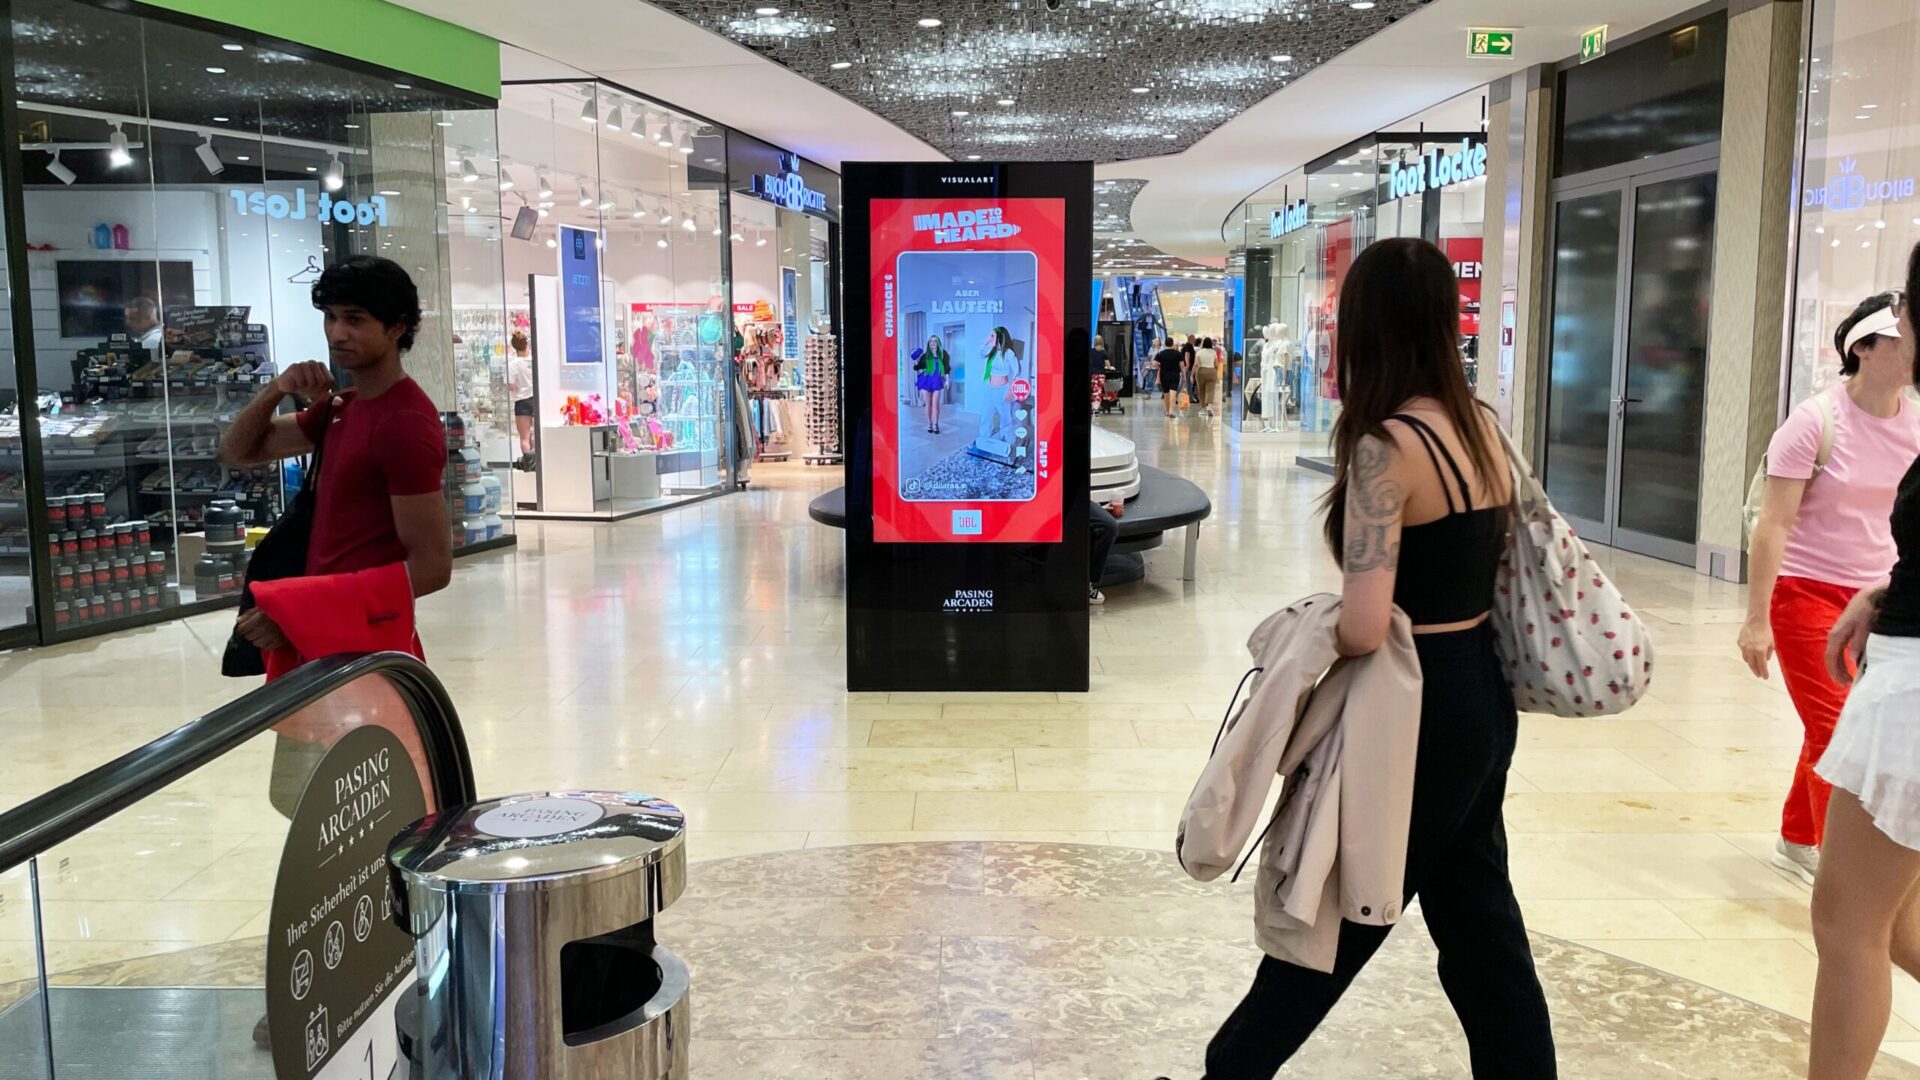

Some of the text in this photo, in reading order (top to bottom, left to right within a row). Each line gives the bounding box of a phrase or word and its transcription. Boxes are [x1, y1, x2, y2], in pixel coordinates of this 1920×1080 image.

[1390, 137, 1487, 200] Foot Locke
[918, 208, 988, 231] MADE
[987, 208, 1002, 216] TO
[934, 223, 1014, 243] HEARD
[884, 282, 893, 337] CHARGE
[931, 300, 1004, 313] LAUTER!
[1013, 384, 1029, 394] JBL
[1039, 441, 1047, 467] FLIP
[959, 516, 977, 528] JBL
[943, 599, 993, 607] ARCADEN
[955, 590, 993, 598] PASING
[334, 747, 389, 805] PASING
[318, 775, 390, 852] ARCADEN
[286, 920, 308, 947] Ihre
[310, 875, 357, 927] Sicherheit
[358, 866, 369, 885] ist
[336, 1015, 354, 1038] Bitte
[374, 980, 385, 998] Sie
